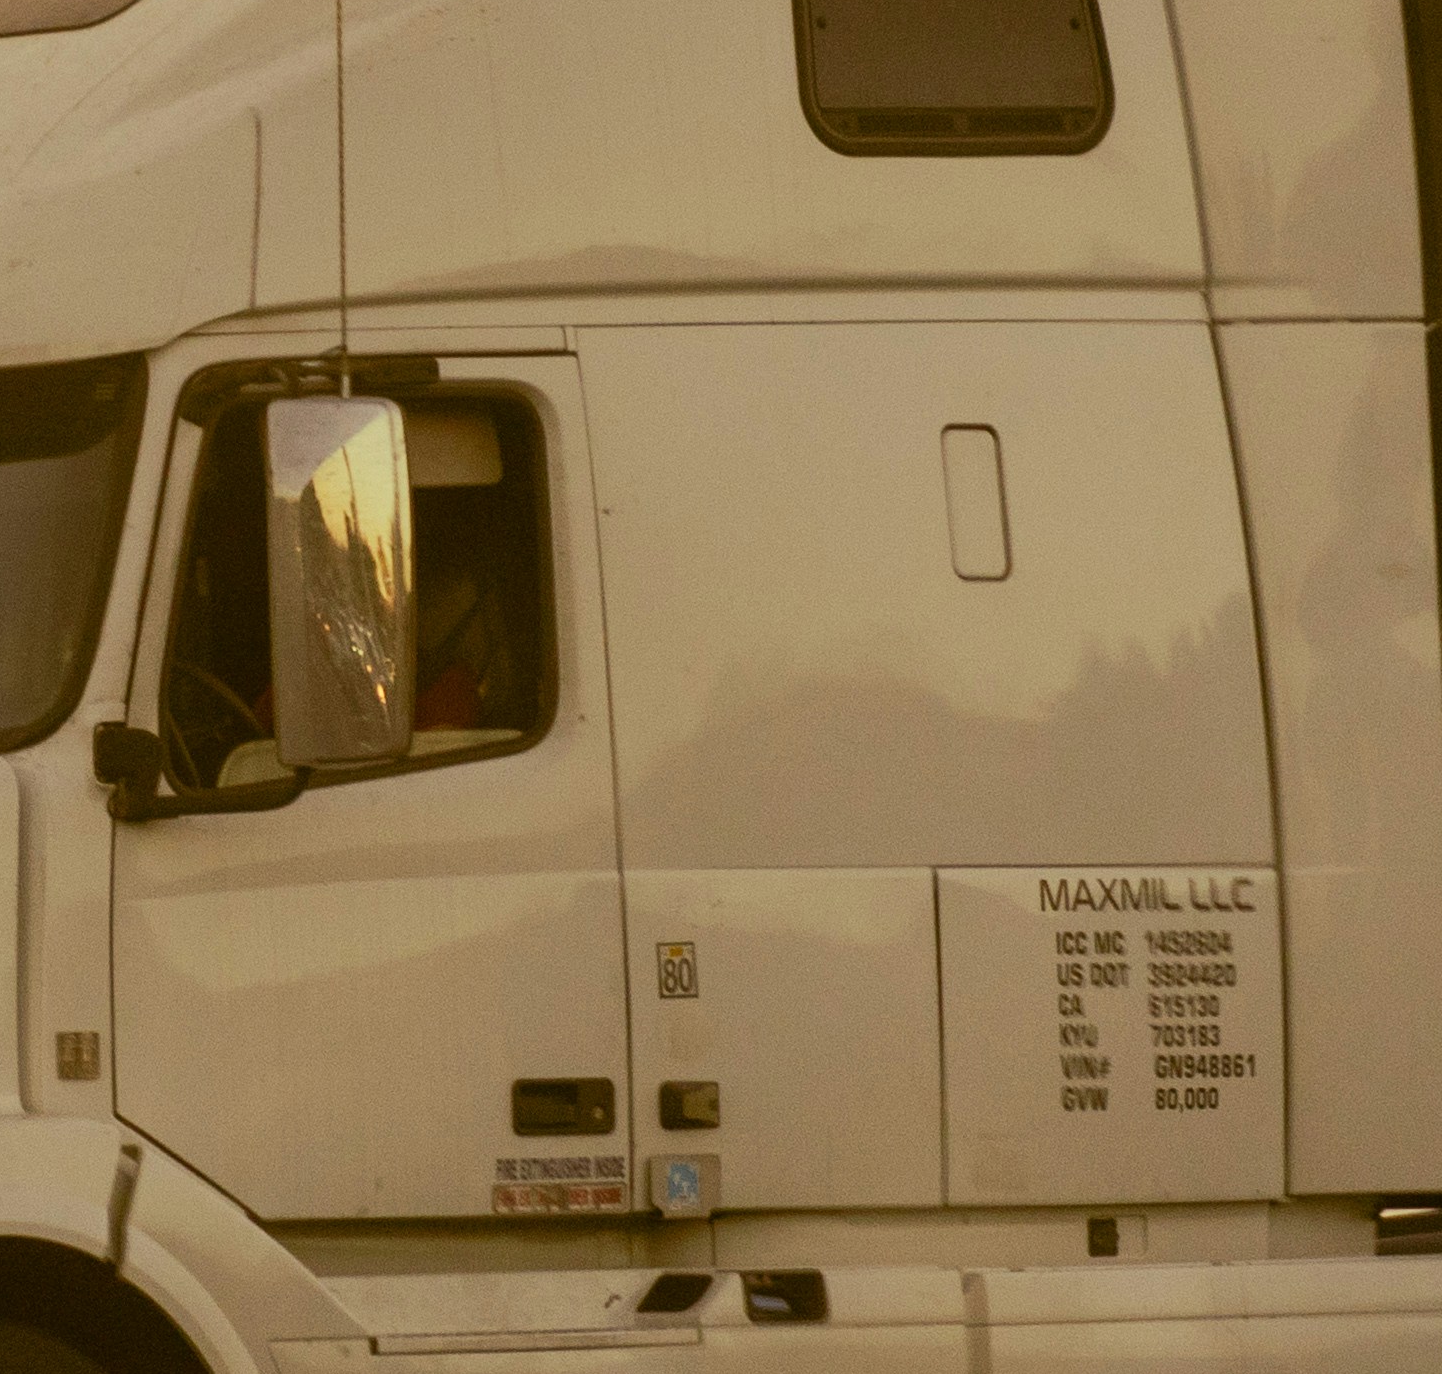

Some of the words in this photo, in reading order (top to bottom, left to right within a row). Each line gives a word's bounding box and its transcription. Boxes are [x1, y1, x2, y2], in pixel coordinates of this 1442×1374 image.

[1038, 877, 1181, 912] MAXMIL
[1188, 876, 1257, 913] LLC
[1055, 930, 1088, 955] ICC
[1093, 930, 1126, 955] MC
[664, 957, 693, 993] 80
[1056, 963, 1085, 987] US
[1090, 962, 1130, 988] DOT
[1058, 993, 1086, 1017] CA
[1154, 1054, 1257, 1079] GN948861
[1061, 1086, 1109, 1111] GVW
